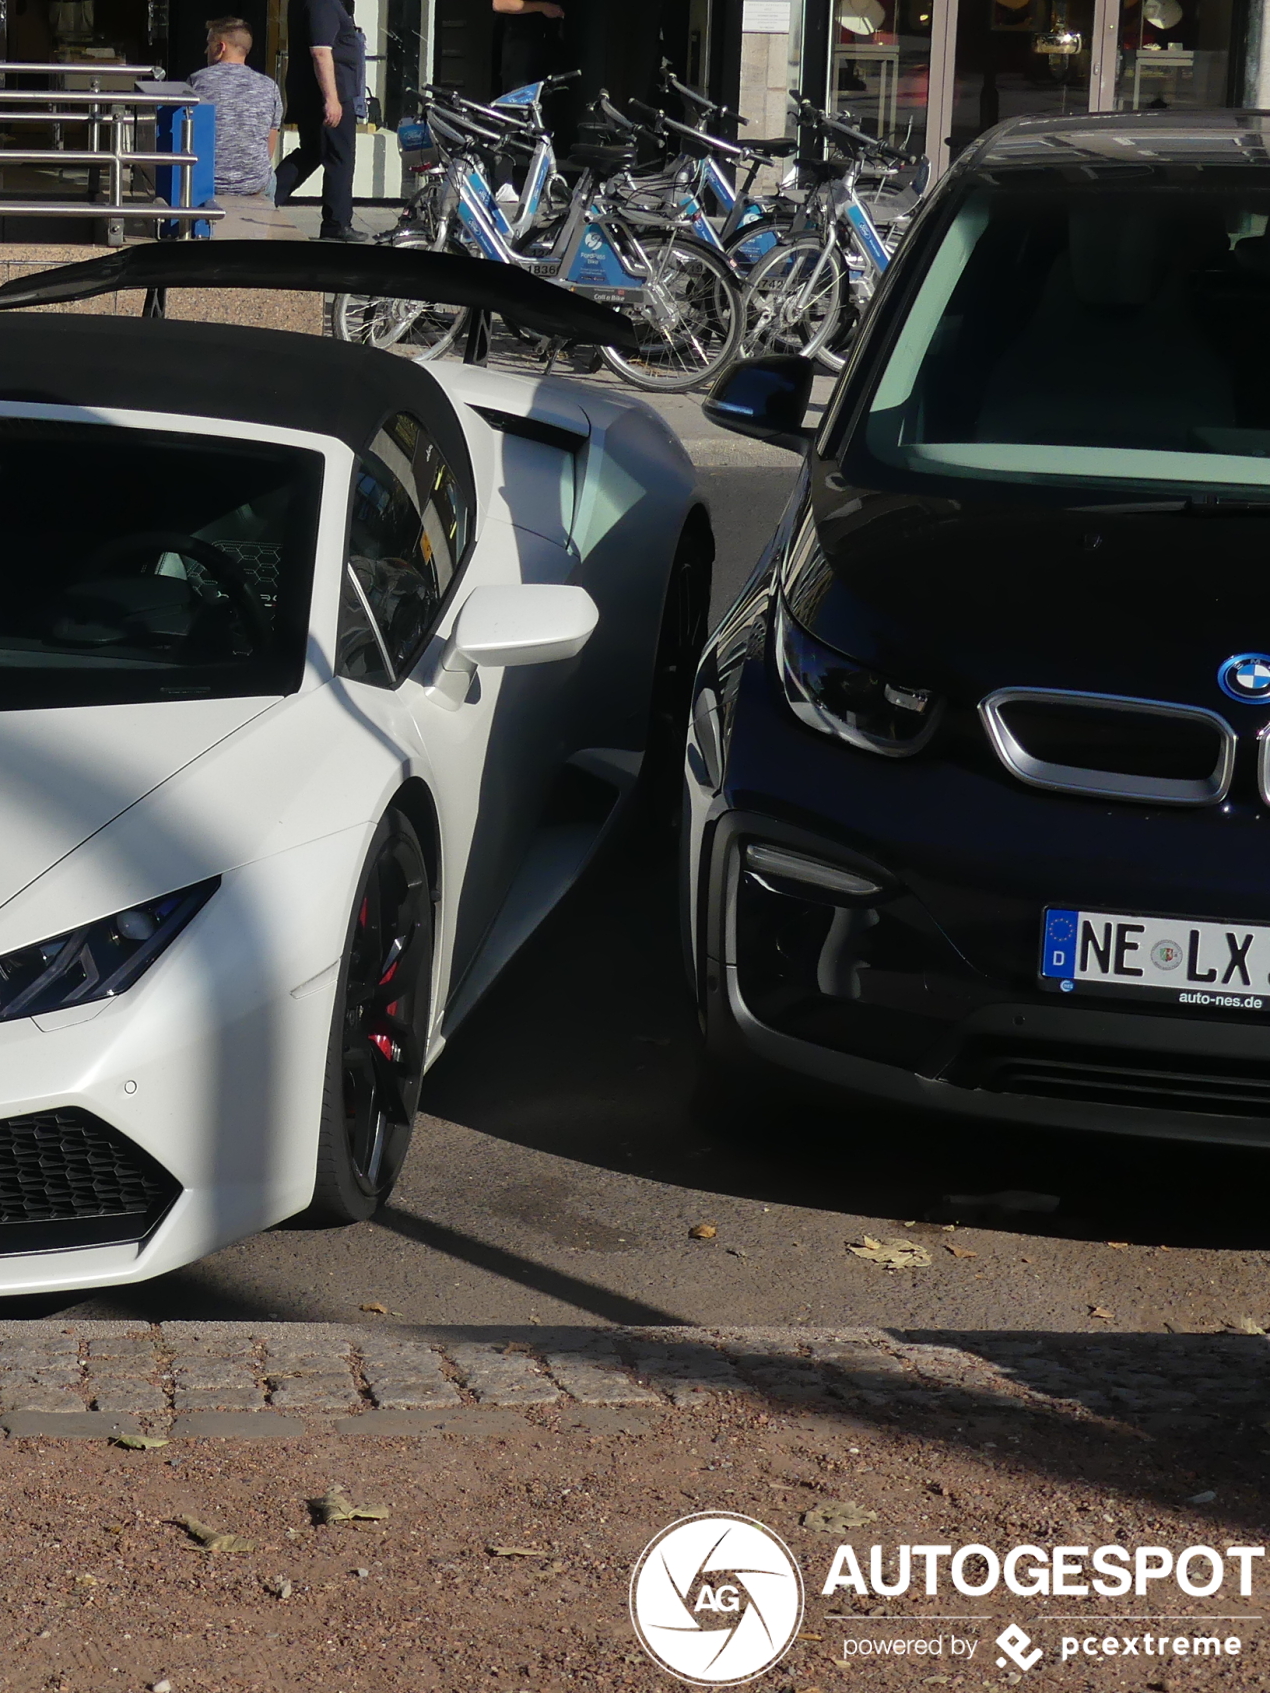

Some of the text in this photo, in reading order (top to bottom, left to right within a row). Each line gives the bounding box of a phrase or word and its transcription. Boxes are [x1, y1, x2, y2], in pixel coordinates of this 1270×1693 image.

[1231, 659, 1270, 671] BM
[1053, 950, 1065, 966] D
[1080, 920, 1145, 977] NE
[1187, 929, 1254, 986] LX
[1179, 992, 1263, 1009] auto-nes.de
